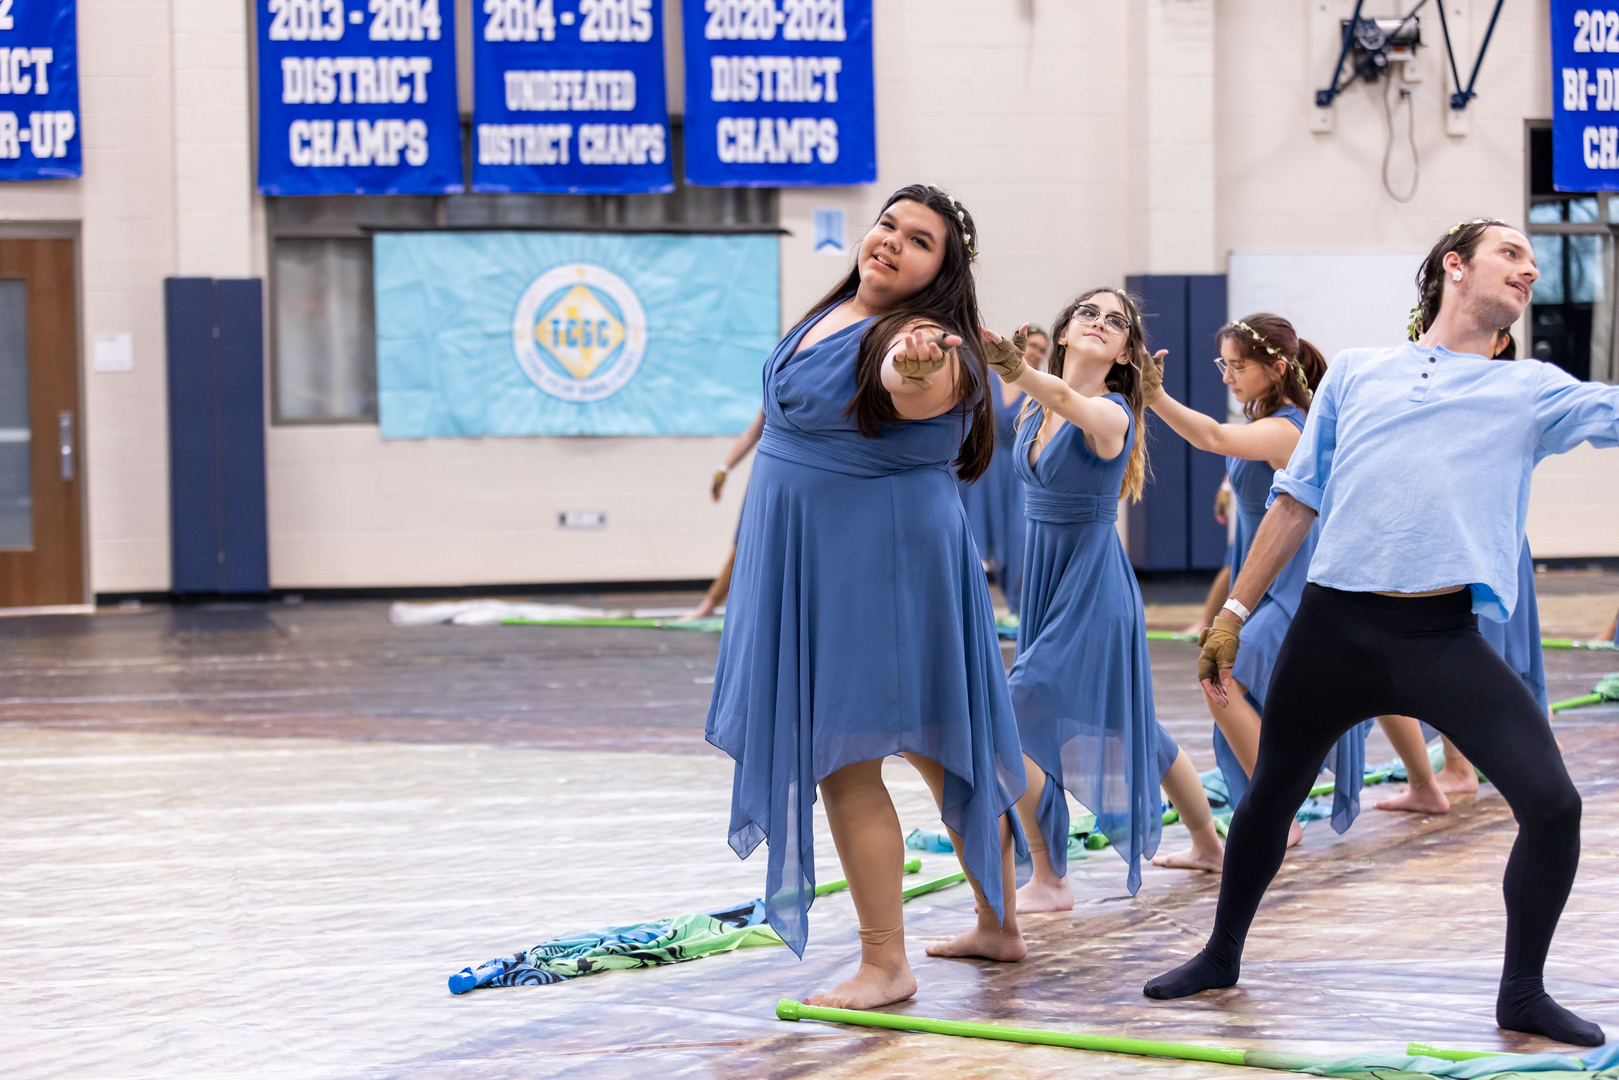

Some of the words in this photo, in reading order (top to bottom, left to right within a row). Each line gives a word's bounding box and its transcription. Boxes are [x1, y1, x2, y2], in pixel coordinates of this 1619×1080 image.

[282, 57, 431, 103] DISTRICT
[505, 71, 635, 110] UNDEFEATED
[712, 56, 841, 102] DISTRICT
[290, 120, 427, 166] CHAMPS
[478, 124, 571, 164] DISTRICT
[579, 124, 664, 163] CHAMPS
[717, 118, 838, 163] CHAMPS
[1583, 127, 1619, 169] CH
